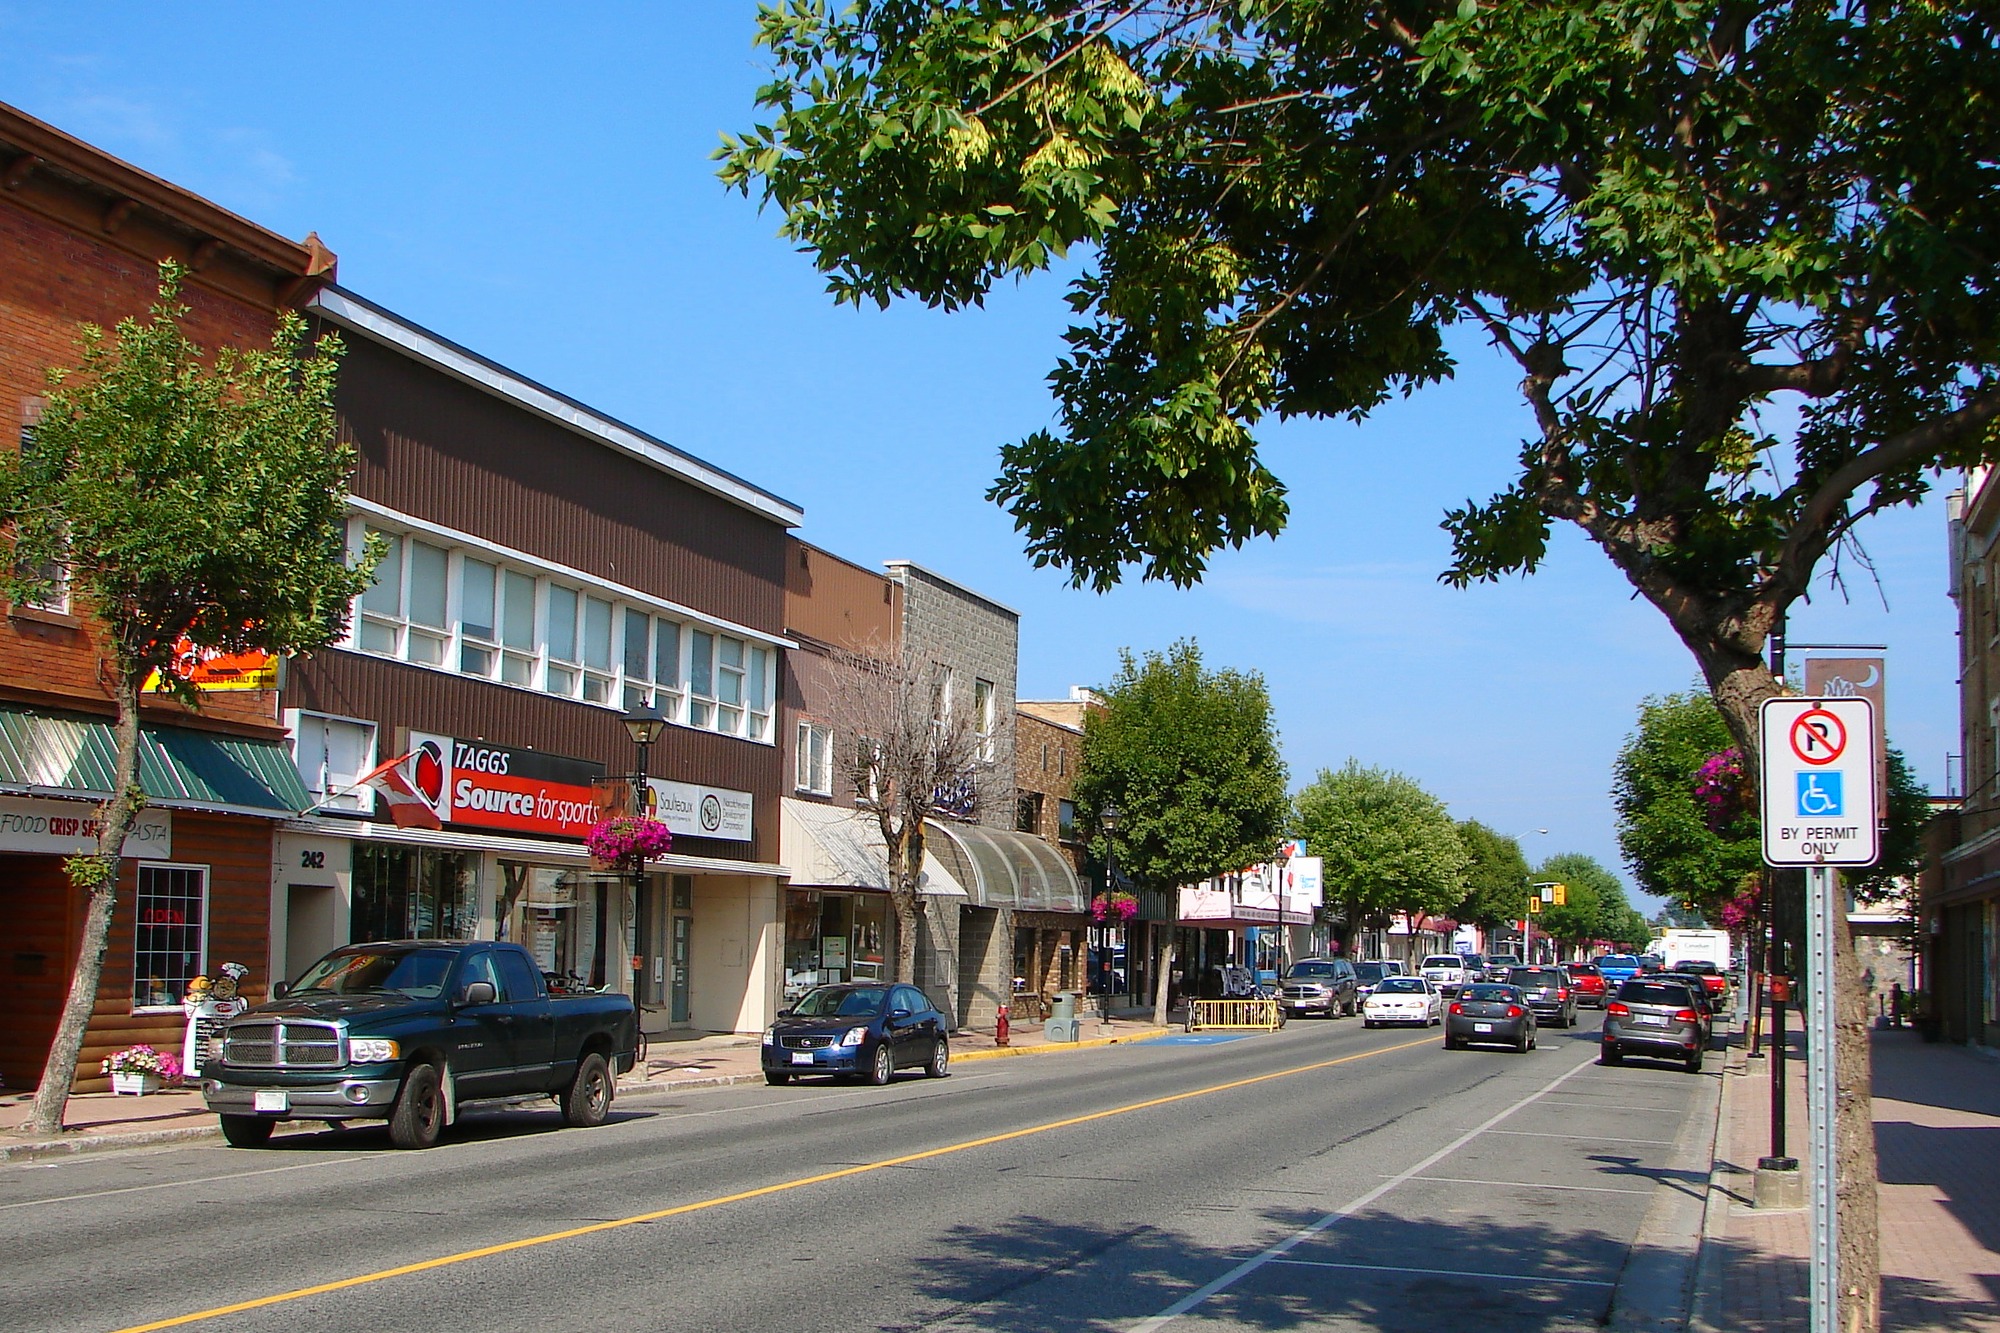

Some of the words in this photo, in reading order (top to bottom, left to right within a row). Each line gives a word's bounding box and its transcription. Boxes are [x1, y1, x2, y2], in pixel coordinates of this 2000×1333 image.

[227, 675, 250, 684] FAMILY
[252, 674, 276, 683] DINING
[454, 742, 510, 775] TAGGS
[454, 779, 535, 816] Source
[536, 788, 559, 820] for
[557, 799, 600, 829] sports
[660, 792, 693, 813] Saulteaux
[0, 813, 48, 834] FOOD
[49, 816, 79, 837] CRISP
[126, 820, 167, 841] PASTA
[1781, 827, 1799, 840] BY
[1807, 827, 1858, 840] PERMIT
[1801, 842, 1839, 855] ONLY
[301, 850, 325, 869] 242
[144, 908, 185, 928] OPEN
